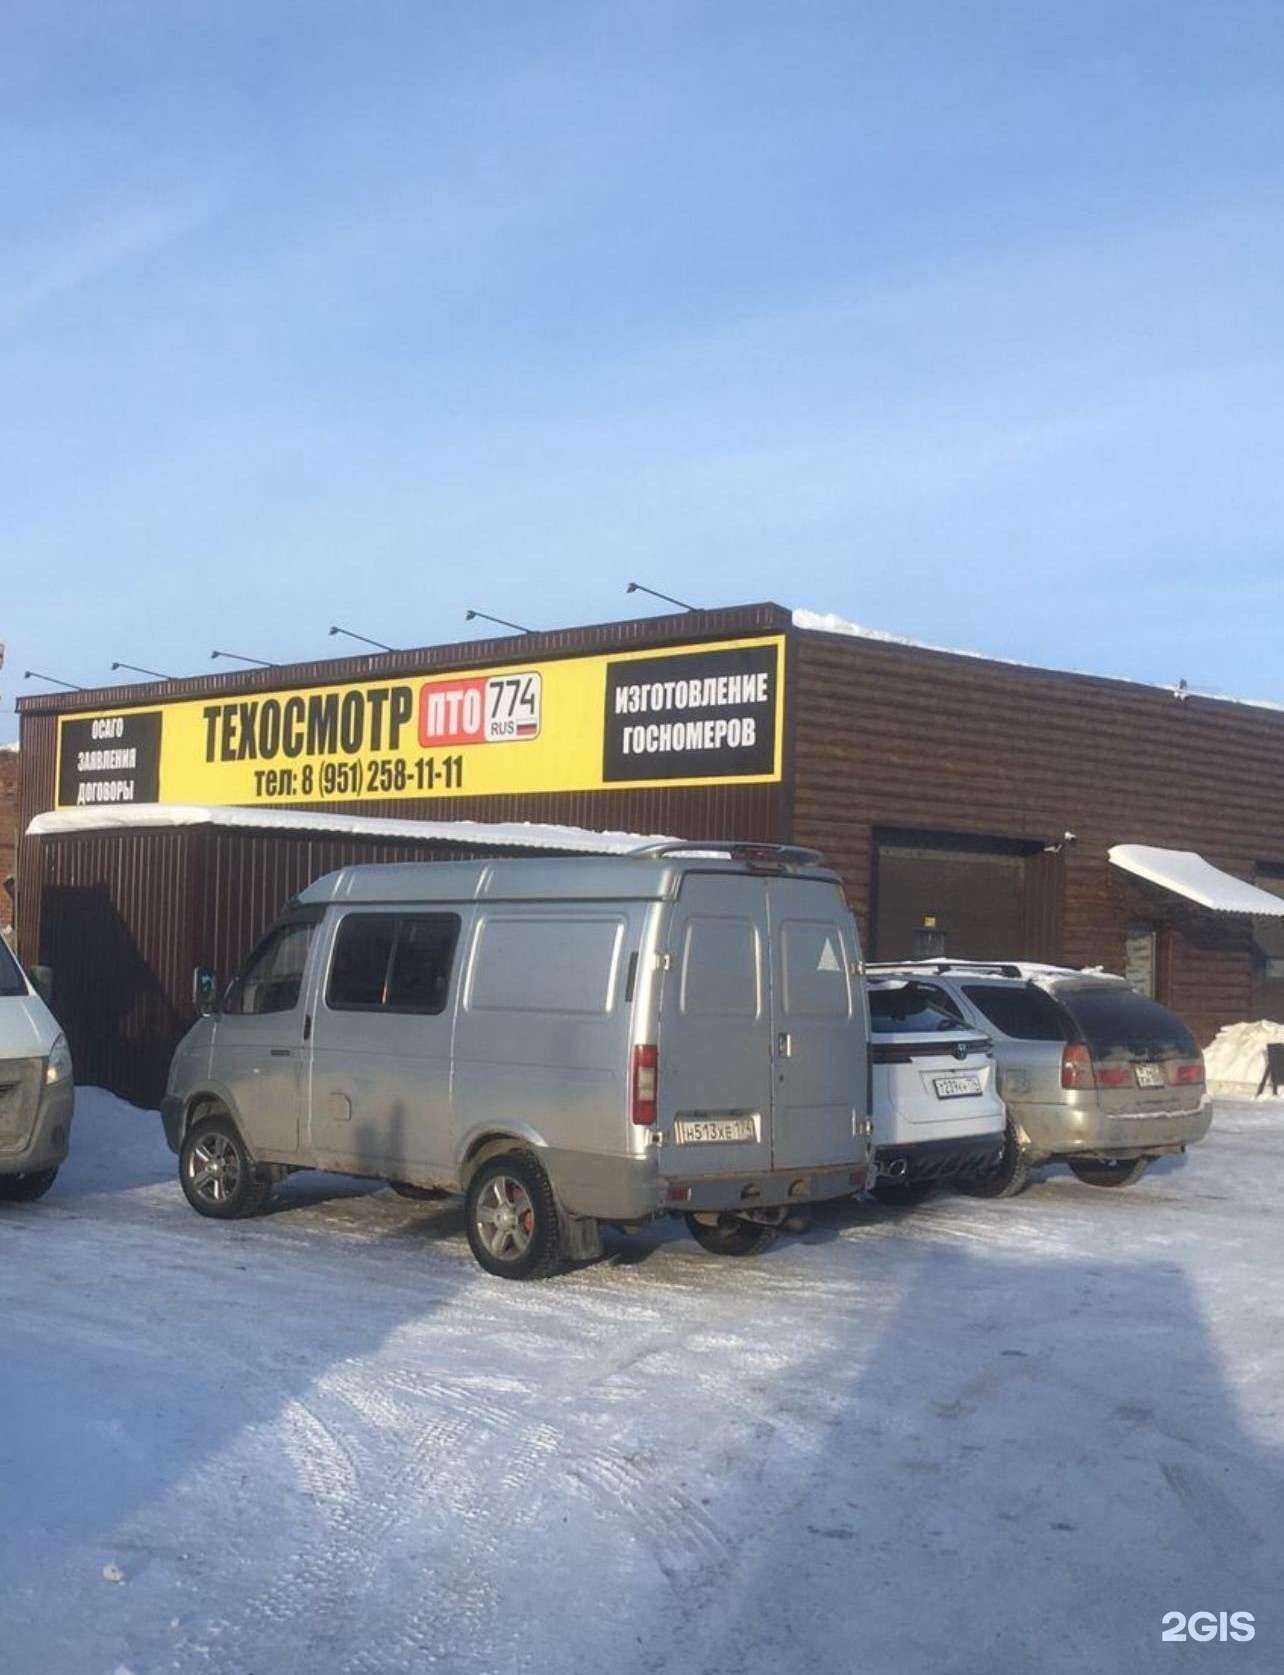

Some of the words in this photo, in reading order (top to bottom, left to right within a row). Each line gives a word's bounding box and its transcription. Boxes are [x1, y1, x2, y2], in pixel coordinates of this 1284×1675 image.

[490, 677, 535, 719] 774
[615, 673, 768, 714] ИЗГОТОВЛЕНИЕ
[91, 717, 124, 739] ОСАГО
[203, 686, 413, 763] ТЕХОСМОТР
[427, 688, 481, 737] ПТО
[490, 721, 514, 736] RUS
[622, 717, 756, 754] ГОСНОМЕРОВ
[77, 748, 137, 771] ЗАЯВЛЕНИЯ
[254, 767, 297, 797] тел:
[301, 764, 313, 795] 8
[319, 759, 363, 798] (951)
[367, 755, 464, 793] 258-11-11
[77, 780, 135, 806] ДОГОВОРЫ
